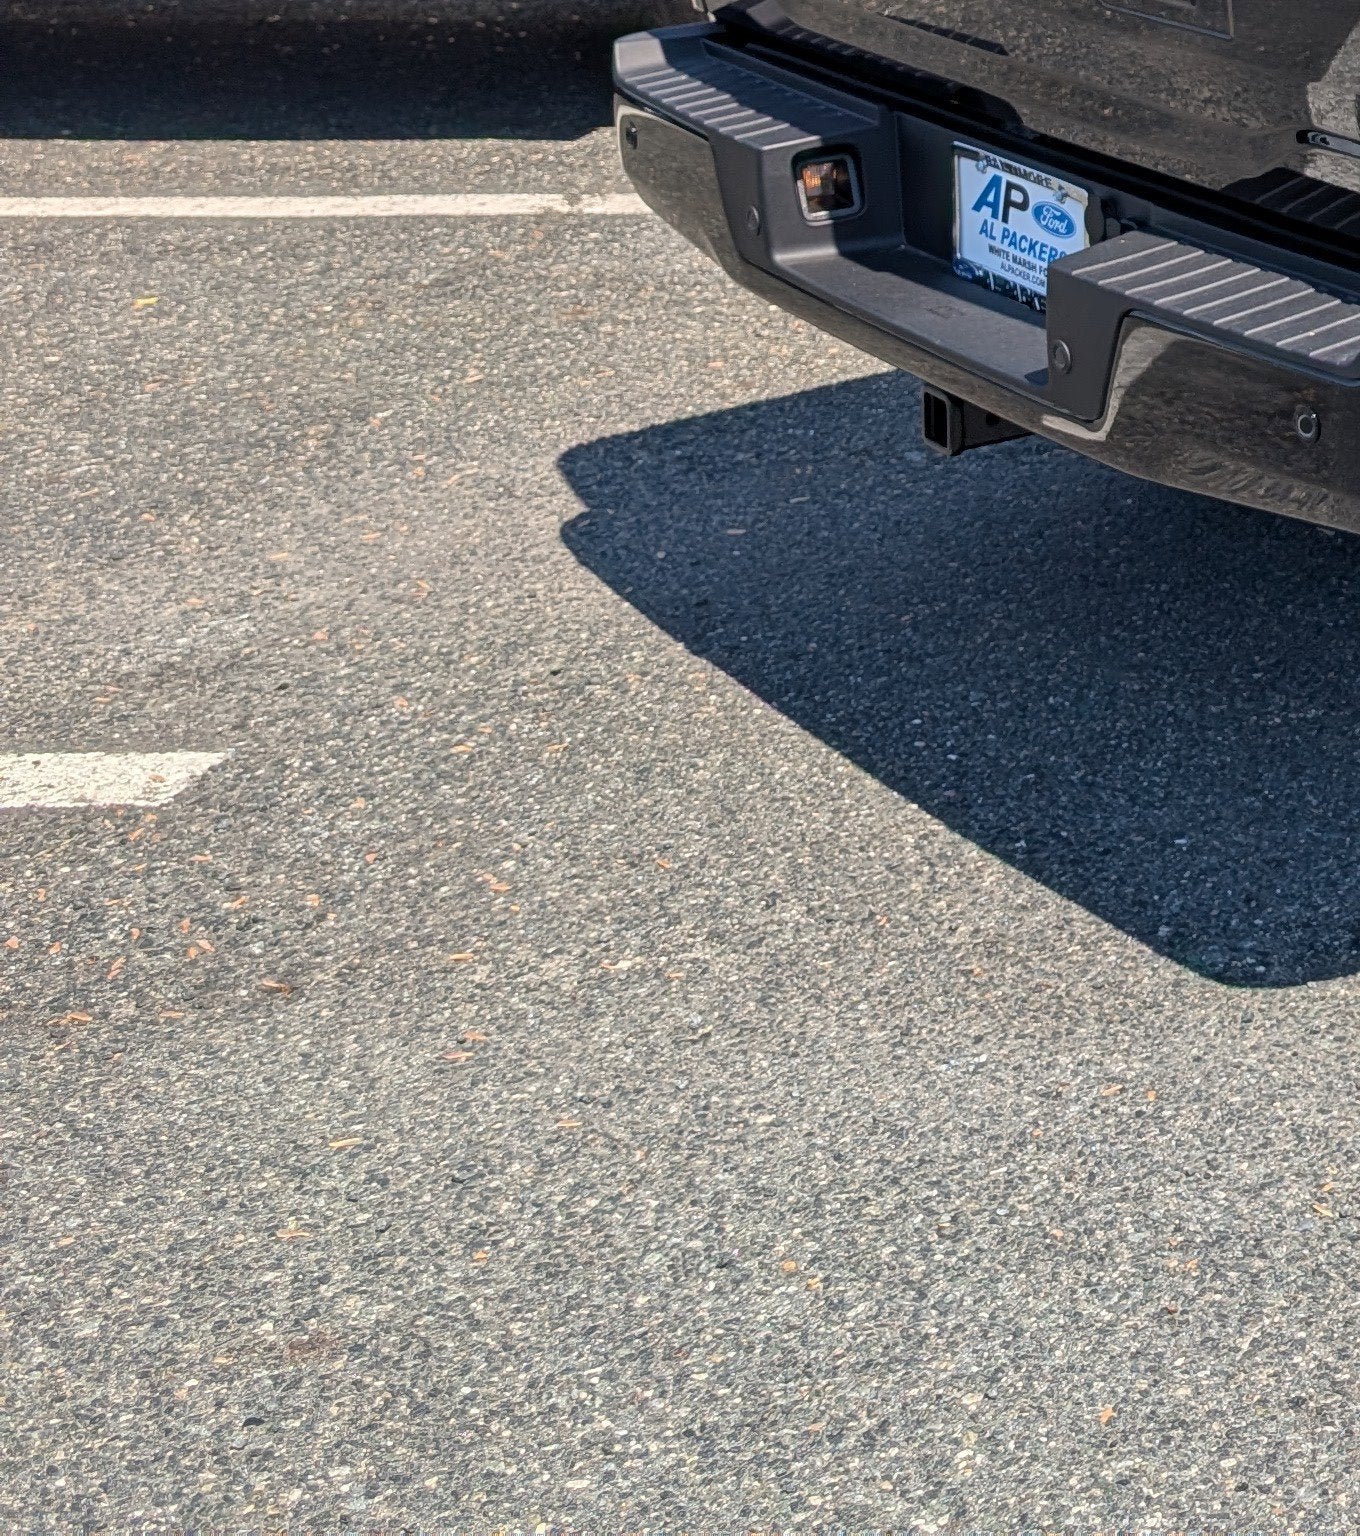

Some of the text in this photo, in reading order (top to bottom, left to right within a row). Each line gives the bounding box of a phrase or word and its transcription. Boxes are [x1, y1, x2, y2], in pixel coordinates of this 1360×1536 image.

[971, 173, 1031, 225] AP
[978, 218, 997, 241] AL
[988, 243, 1011, 261] WHITE
[1011, 251, 1038, 274] MARSH
